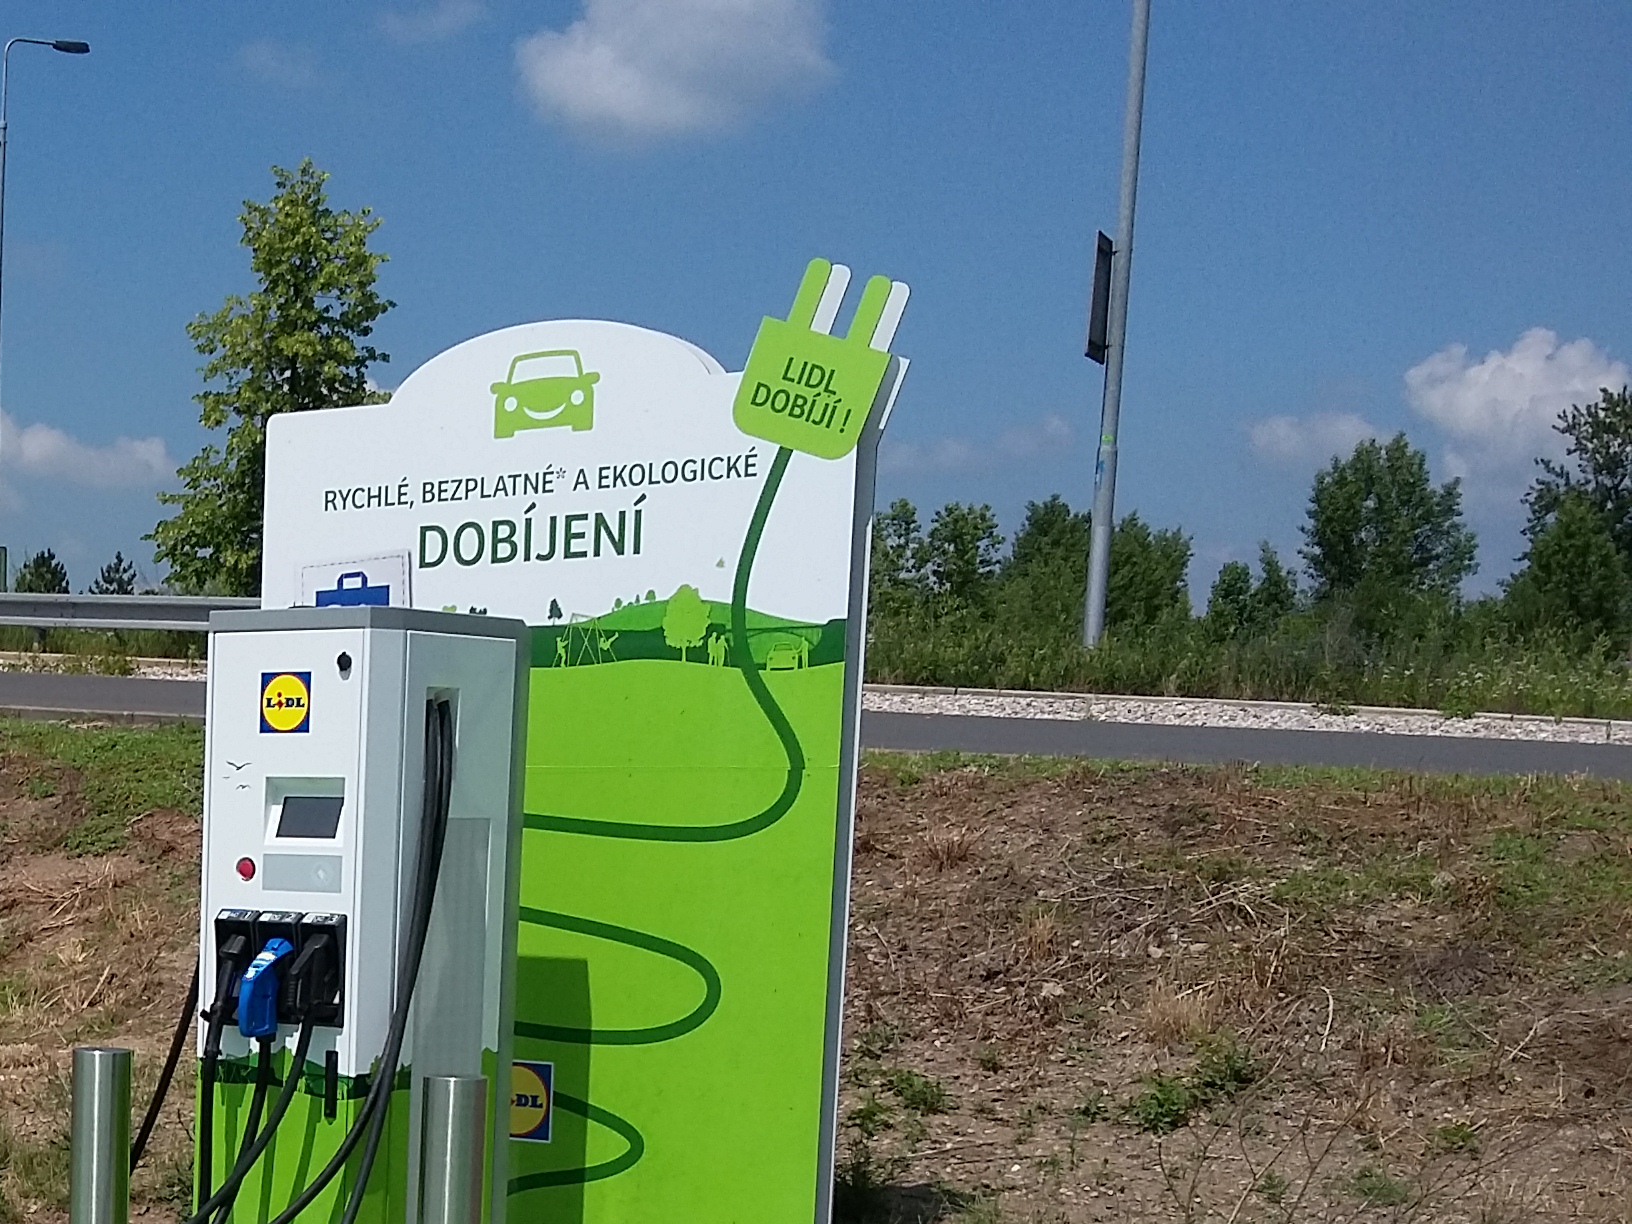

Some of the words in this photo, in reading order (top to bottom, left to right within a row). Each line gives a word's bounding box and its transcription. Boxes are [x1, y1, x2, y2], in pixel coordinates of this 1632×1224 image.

[781, 357, 837, 395] LIDL
[323, 478, 415, 512] RYCHLÉ,
[573, 468, 590, 492] A
[597, 447, 759, 490] EKOLOGICKÉ
[418, 492, 647, 570] DOBÍJENÍ
[511, 1093, 543, 1109] DL
